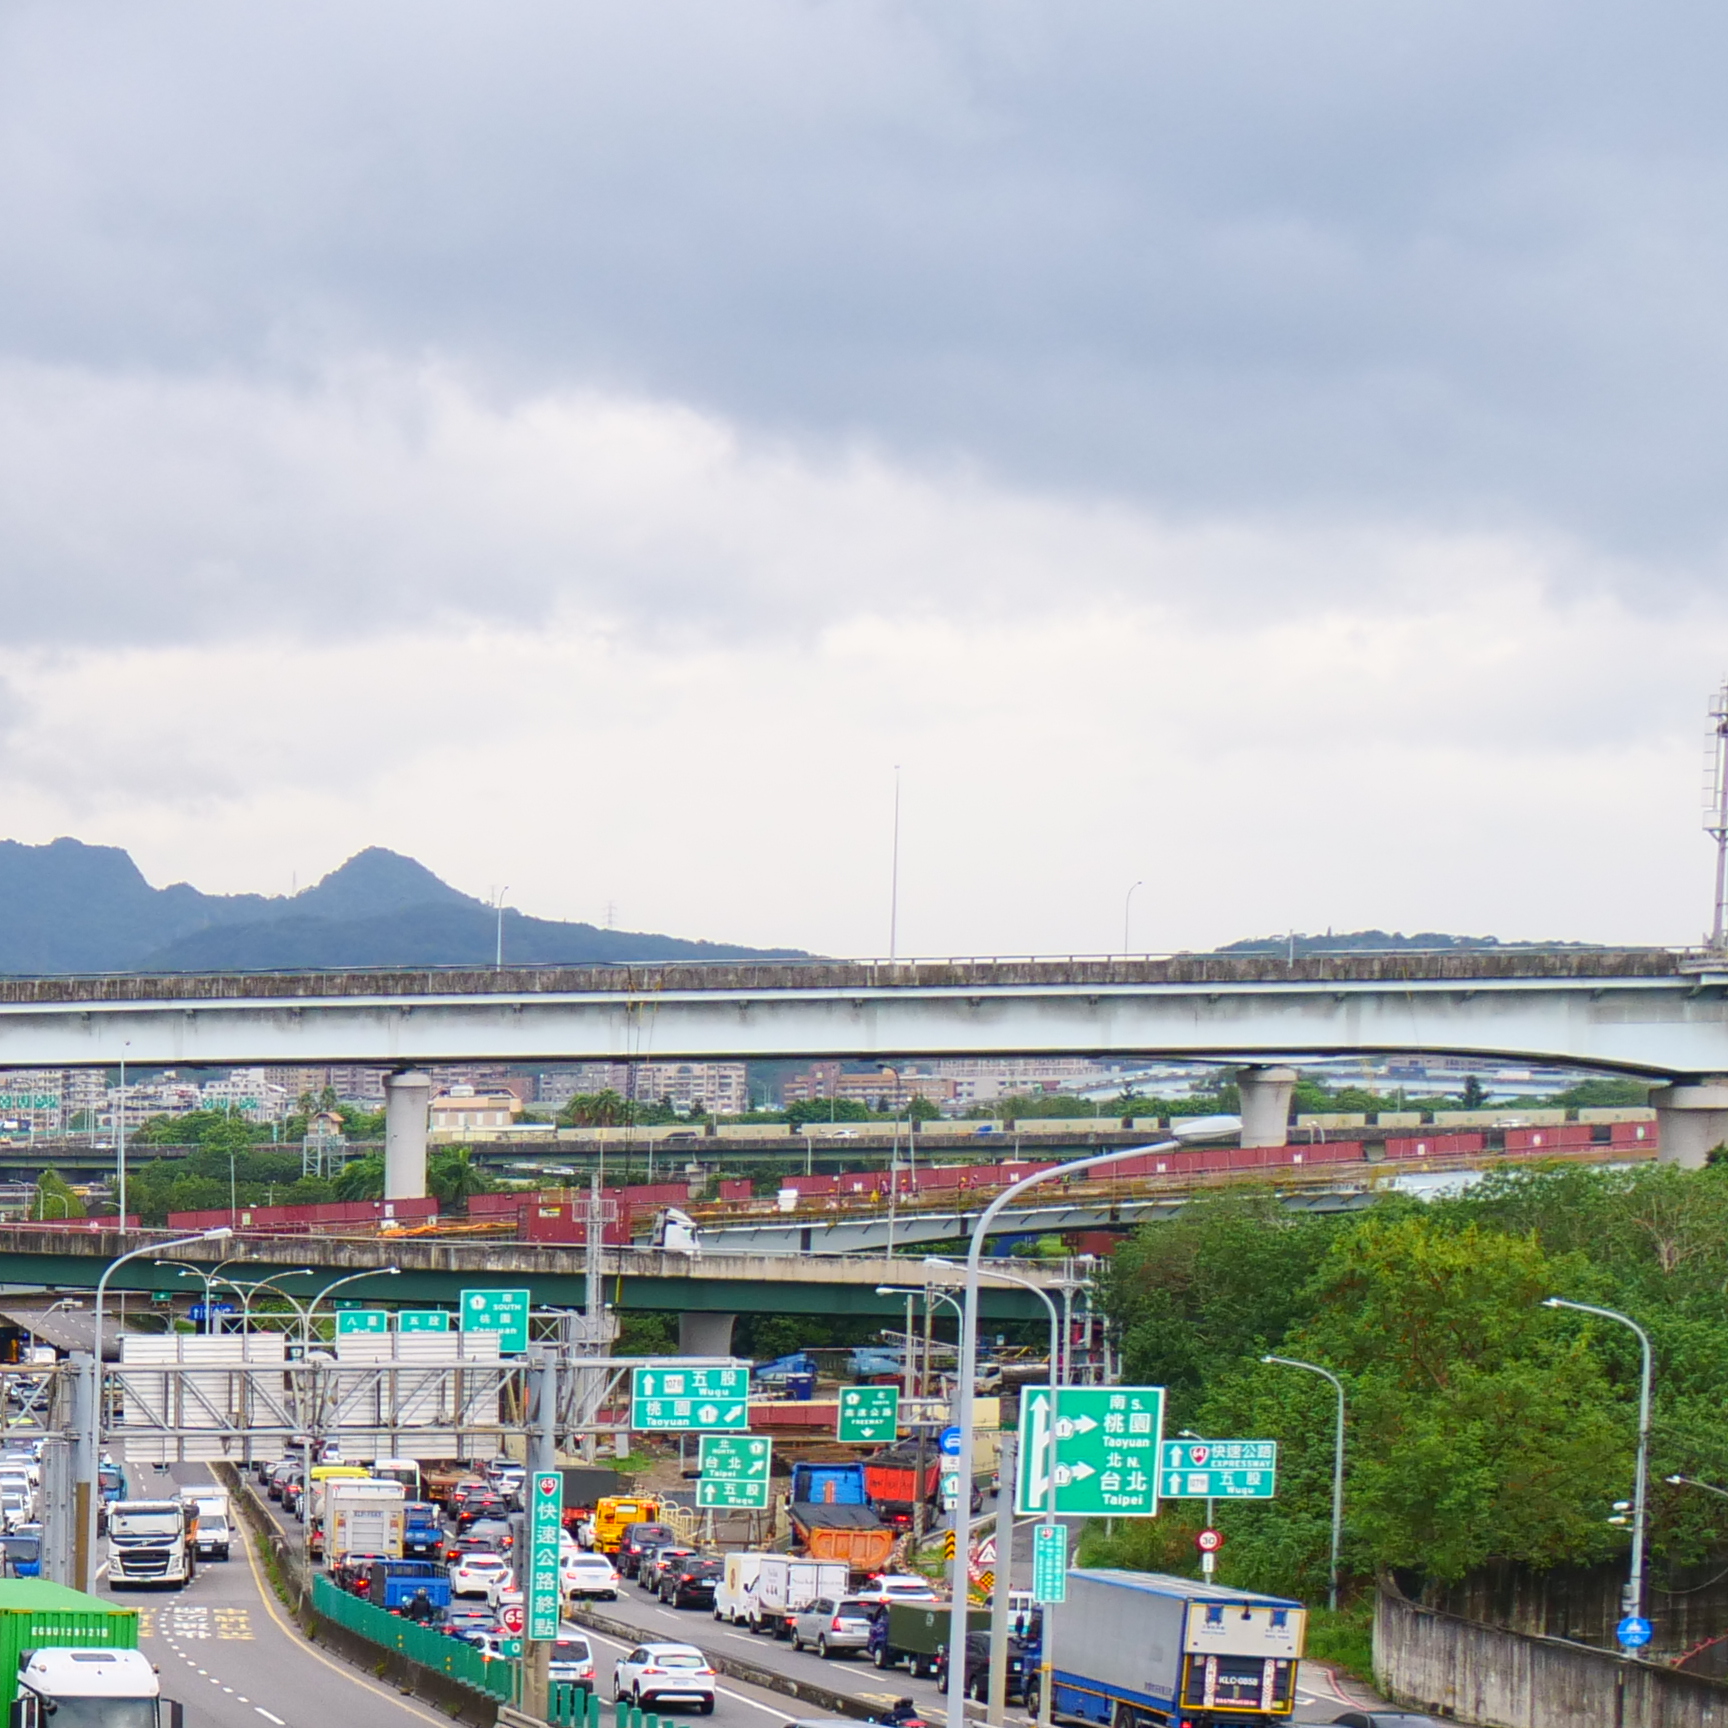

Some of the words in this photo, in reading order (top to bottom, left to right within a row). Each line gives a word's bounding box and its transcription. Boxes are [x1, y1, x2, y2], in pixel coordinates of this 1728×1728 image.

[493, 1303, 522, 1311] SOUTH
[409, 1315, 440, 1327] 五股
[479, 1313, 512, 1324] 桃園
[692, 1371, 737, 1386] 五股
[698, 1388, 729, 1397] Wugu
[646, 1401, 691, 1416] 桃園
[1110, 1395, 1126, 1410] 南
[844, 1407, 892, 1418] 高速公路
[646, 1417, 690, 1427] Taoyuan
[1103, 1412, 1152, 1434] 桃園
[1102, 1436, 1150, 1449] Taoyuan
[1211, 1444, 1272, 1459] 快速公路
[705, 1456, 742, 1469] 台北
[1106, 1452, 1122, 1468] 北
[1210, 1460, 1272, 1468] EXPRESSWAY
[709, 1470, 736, 1478] Taipei
[1219, 1471, 1262, 1486] 五股
[541, 1477, 555, 1489] 65
[1100, 1471, 1148, 1491] 台北
[723, 1483, 760, 1496] 五股
[1226, 1486, 1255, 1495] Wugu
[728, 1496, 754, 1505] Wugu
[1102, 1494, 1143, 1507] Taipei
[534, 1501, 558, 1637] 快速公路終點
[505, 1610, 524, 1624] 65
